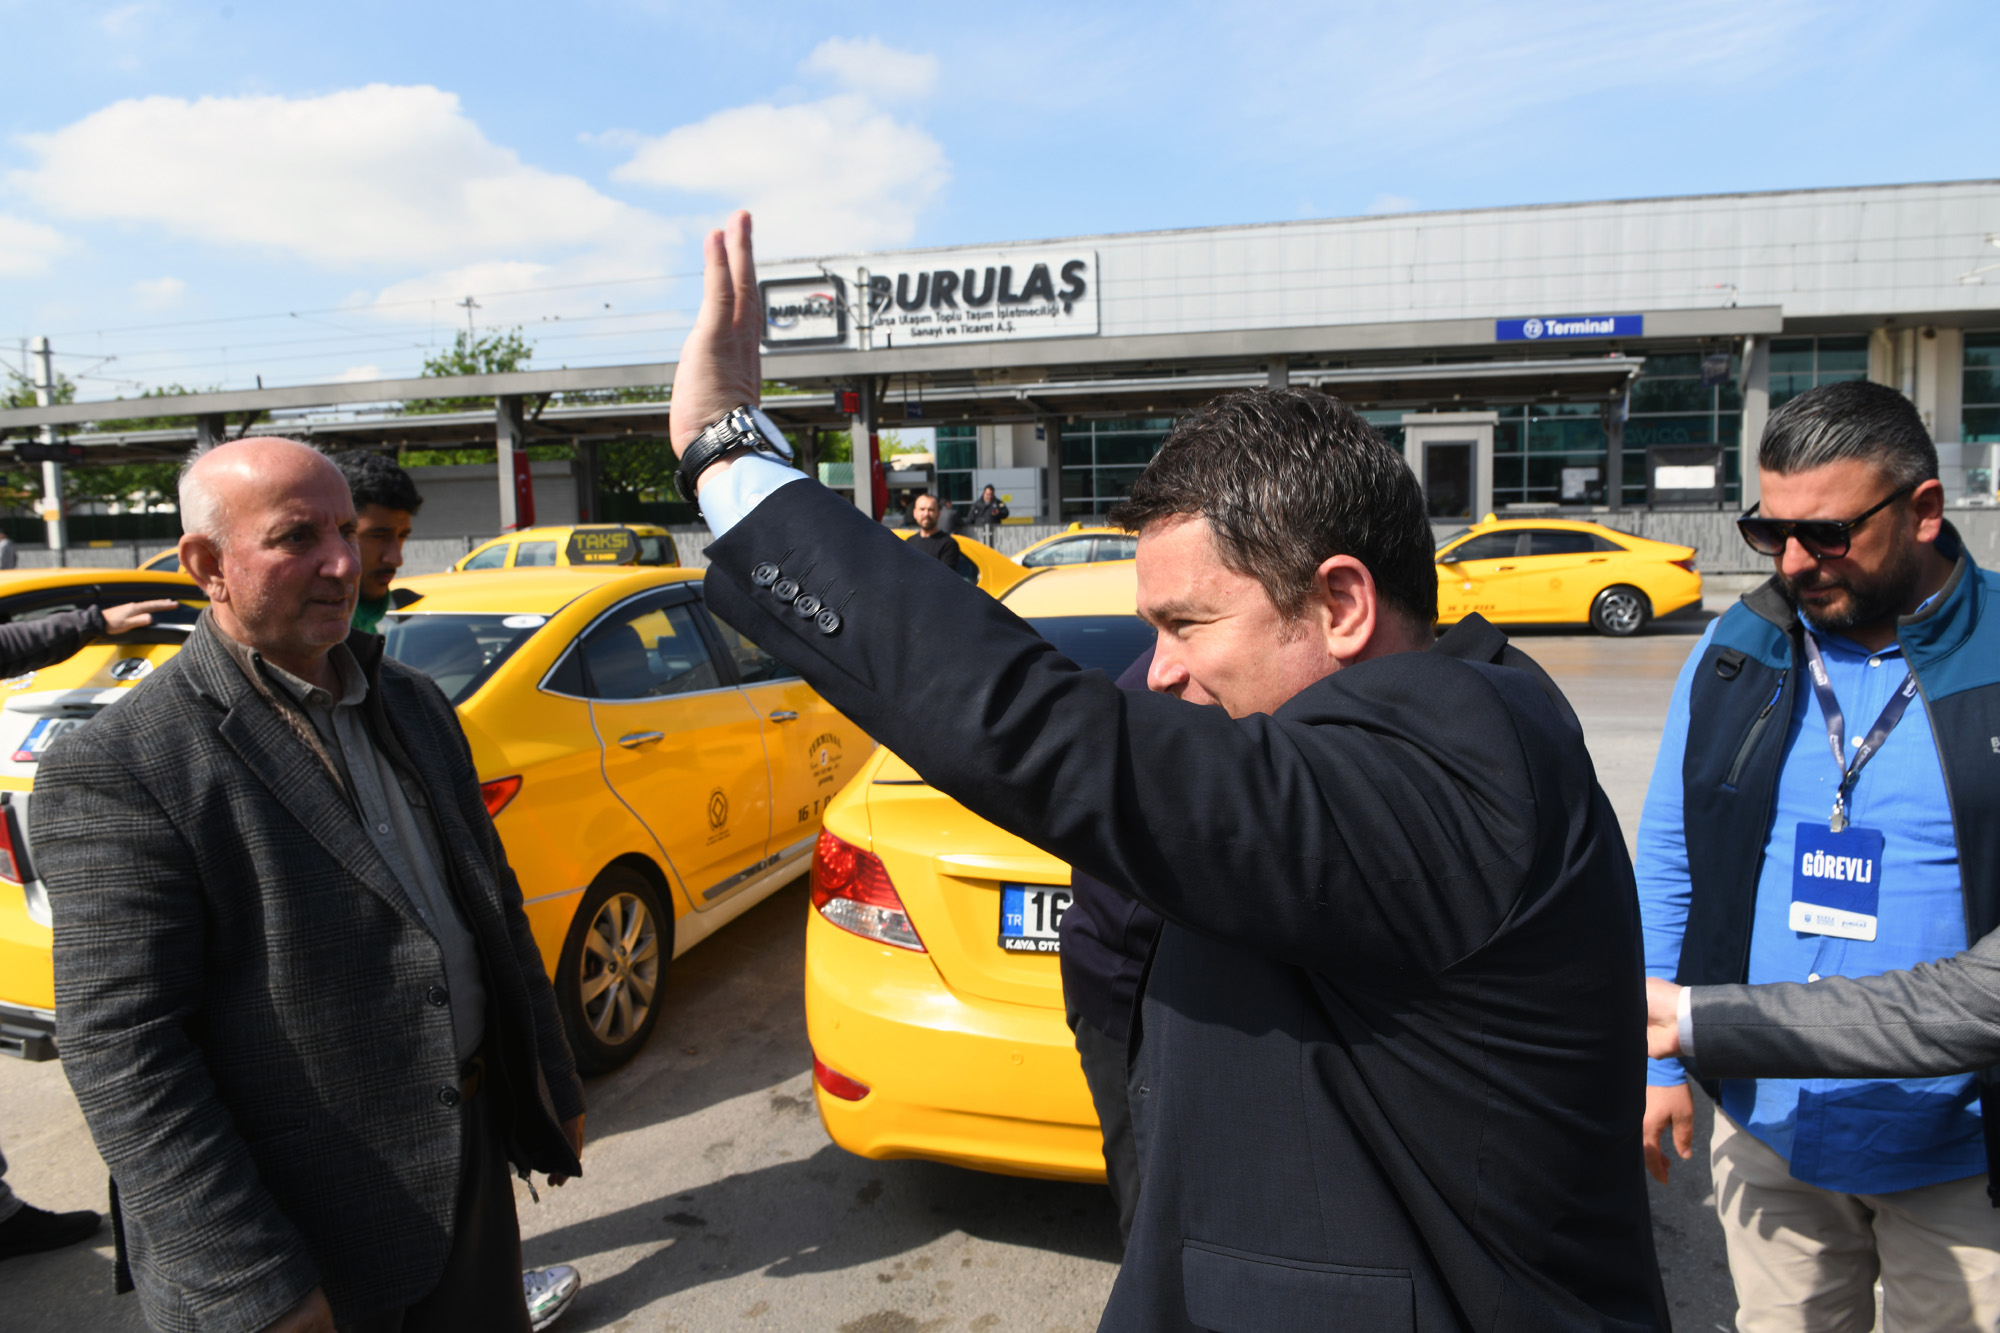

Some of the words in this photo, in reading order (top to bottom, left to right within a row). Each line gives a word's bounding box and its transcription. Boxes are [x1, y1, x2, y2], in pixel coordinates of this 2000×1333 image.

[869, 259, 1087, 315] BURULAŞ
[911, 323, 944, 338] Sanayi
[946, 325, 957, 336] ve
[961, 322, 994, 335] Ticaret
[1545, 317, 1615, 336] Terminal
[798, 804, 809, 824] 16
[1802, 849, 1873, 883] GÖREVLİ
[1006, 913, 1022, 927] TR
[1031, 891, 1071, 934] 16
[1005, 938, 1037, 951] KAYA
